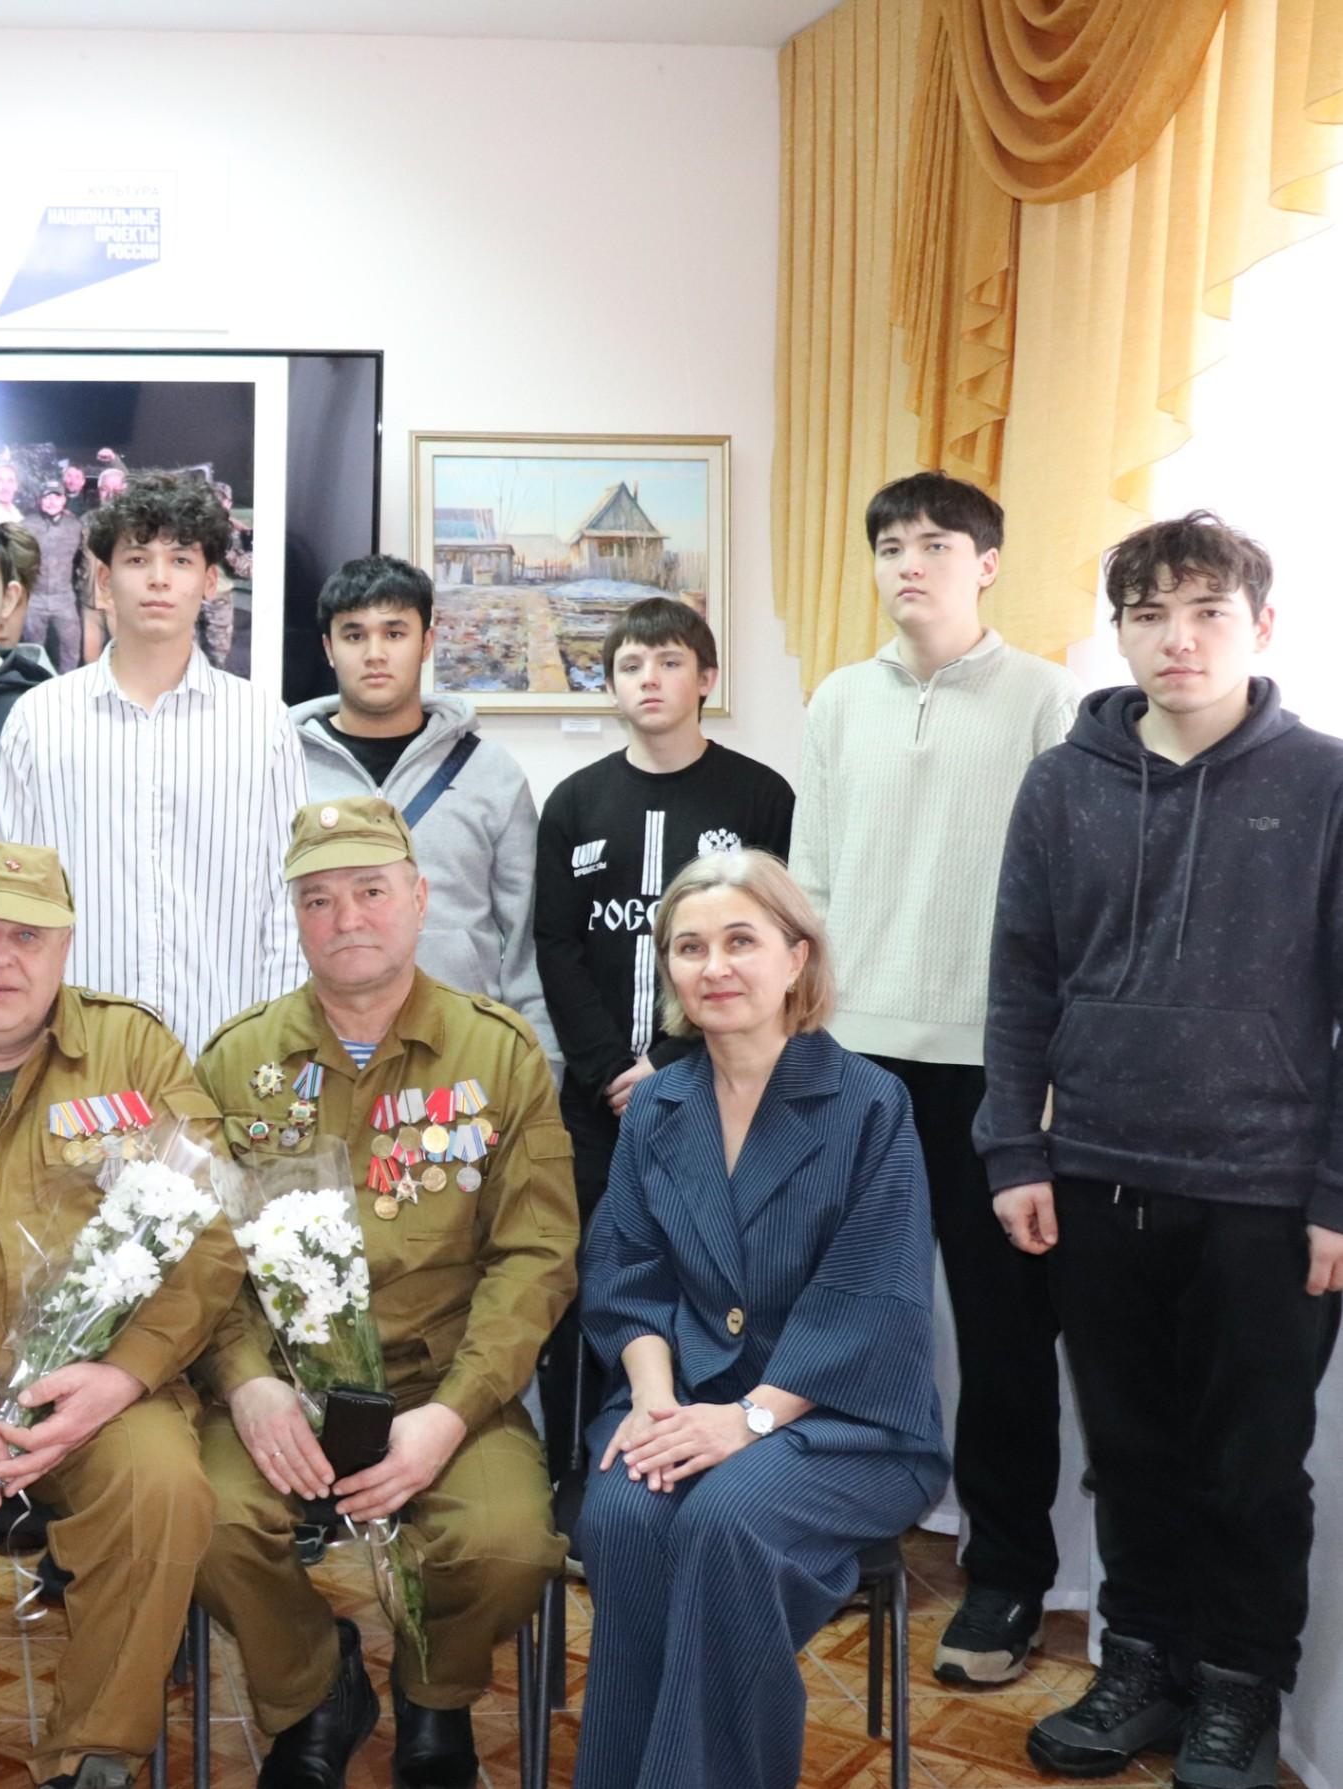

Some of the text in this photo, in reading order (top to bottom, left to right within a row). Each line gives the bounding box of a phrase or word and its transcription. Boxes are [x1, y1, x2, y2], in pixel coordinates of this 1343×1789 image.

[47, 208, 159, 226] НАЦИОНАЛЬНЫЕ
[95, 226, 159, 242] ПРОЕКТЫ
[107, 243, 159, 260] РОССИИ
